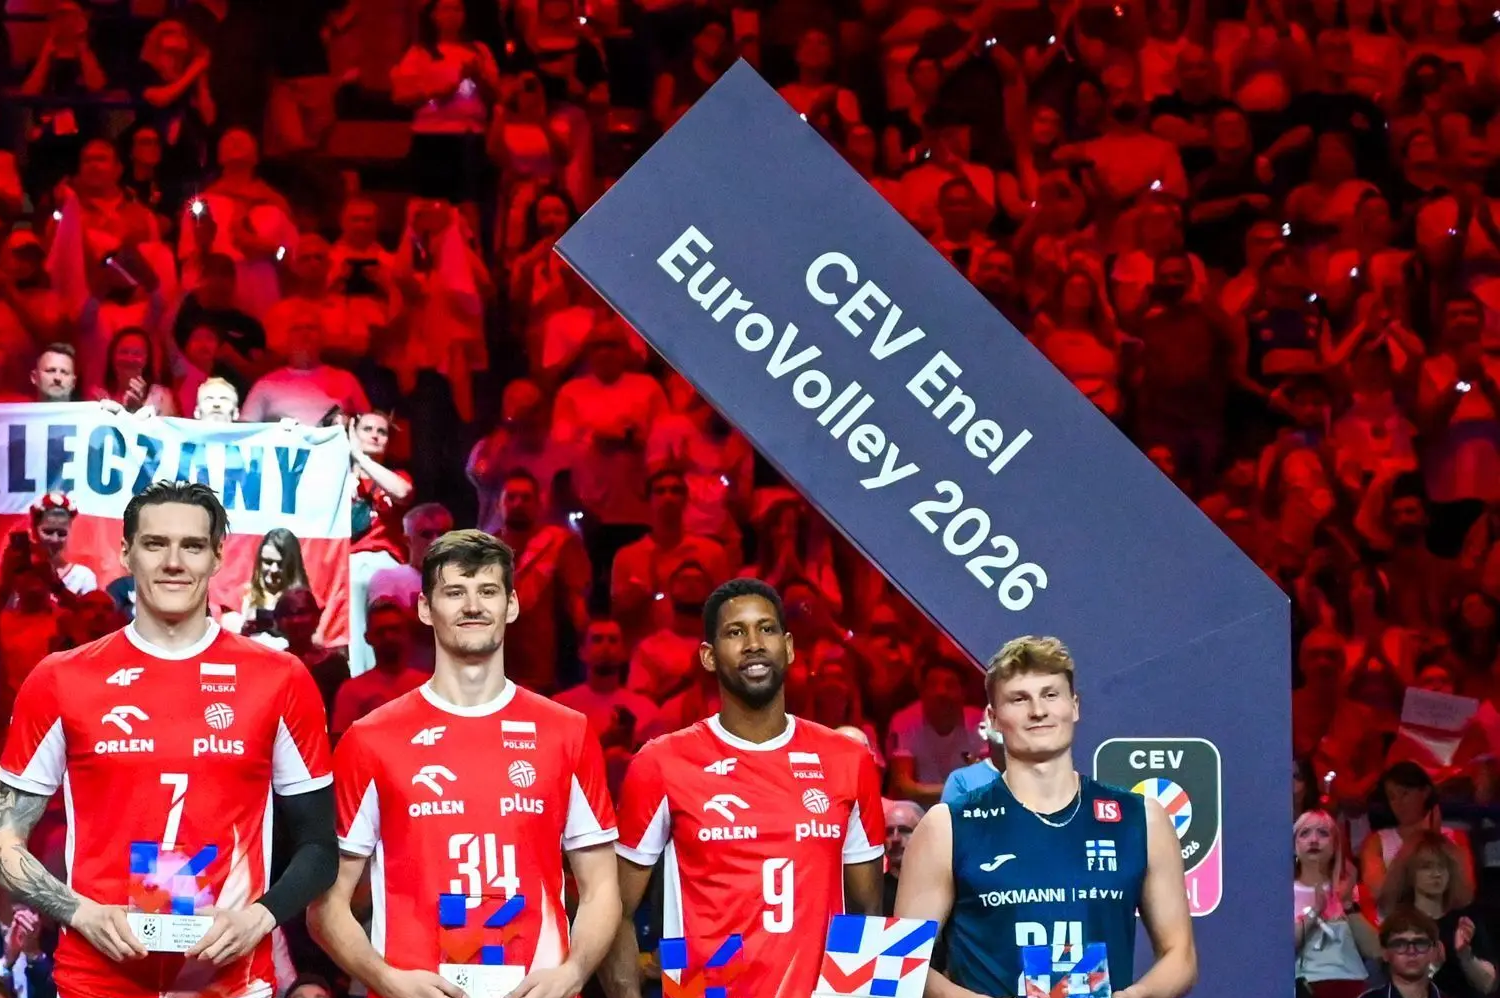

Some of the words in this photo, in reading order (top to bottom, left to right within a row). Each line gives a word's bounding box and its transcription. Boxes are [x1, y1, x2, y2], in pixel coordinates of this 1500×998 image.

[805, 251, 926, 360] CEV
[905, 350, 1033, 475] Enel
[656, 224, 920, 490] EuroVolley
[909, 480, 1048, 611] 2026
[106, 667, 144, 686] 4F
[193, 734, 244, 757] plus
[410, 725, 447, 746] 4F
[503, 741, 536, 750] POLSKA
[94, 738, 154, 754] ORLEN
[703, 757, 738, 775] 4F
[1129, 750, 1184, 769] CEV
[794, 771, 824, 779] POLSKA
[160, 773, 188, 851] 7
[408, 800, 464, 817] ORLEN
[500, 793, 544, 816] plus
[1097, 802, 1117, 820] IS
[698, 825, 757, 842] ORLEN
[795, 819, 841, 842] plus
[1181, 840, 1200, 860] 026
[448, 833, 520, 909] 34
[1087, 857, 1117, 872] FIN
[762, 857, 794, 934] 9
[979, 887, 1066, 907] TOKMANNI
